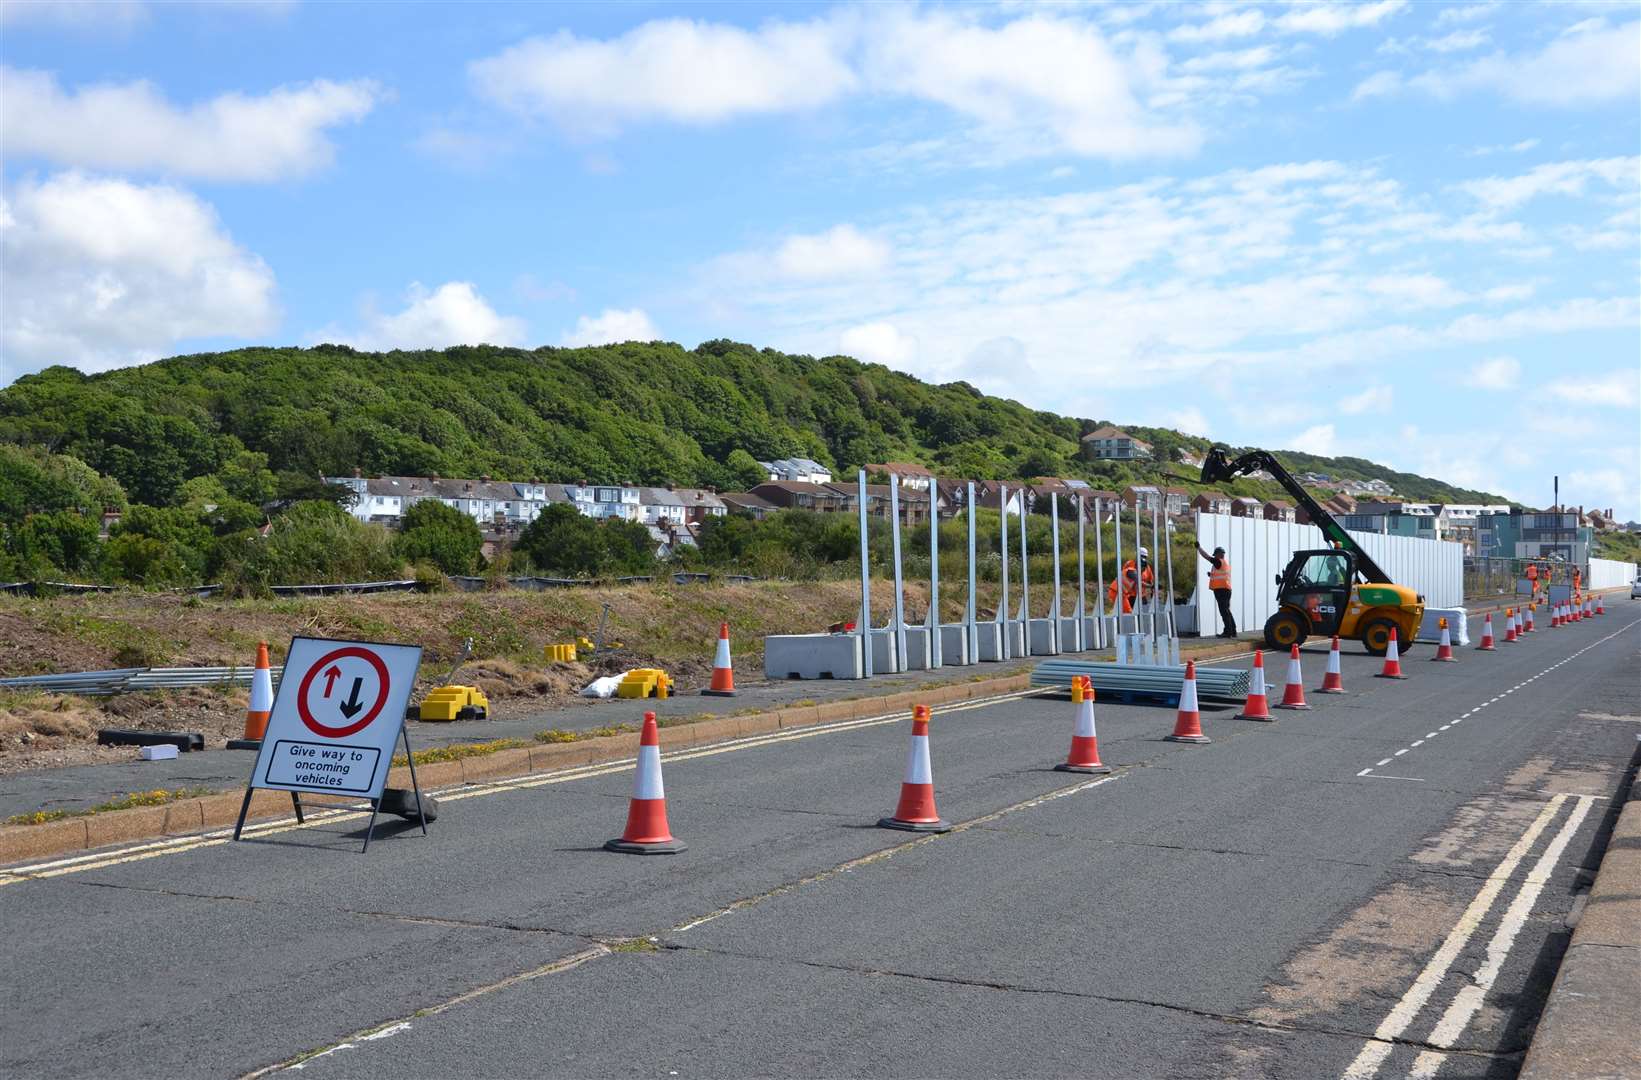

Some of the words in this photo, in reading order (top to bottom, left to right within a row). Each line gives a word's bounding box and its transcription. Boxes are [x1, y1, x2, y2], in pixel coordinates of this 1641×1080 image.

[1312, 605, 1336, 613] JCB
[290, 745, 316, 757] Give
[321, 749, 345, 761] way
[351, 750, 363, 761] to
[295, 761, 350, 775] oncoming
[295, 773, 343, 786] vehicles
